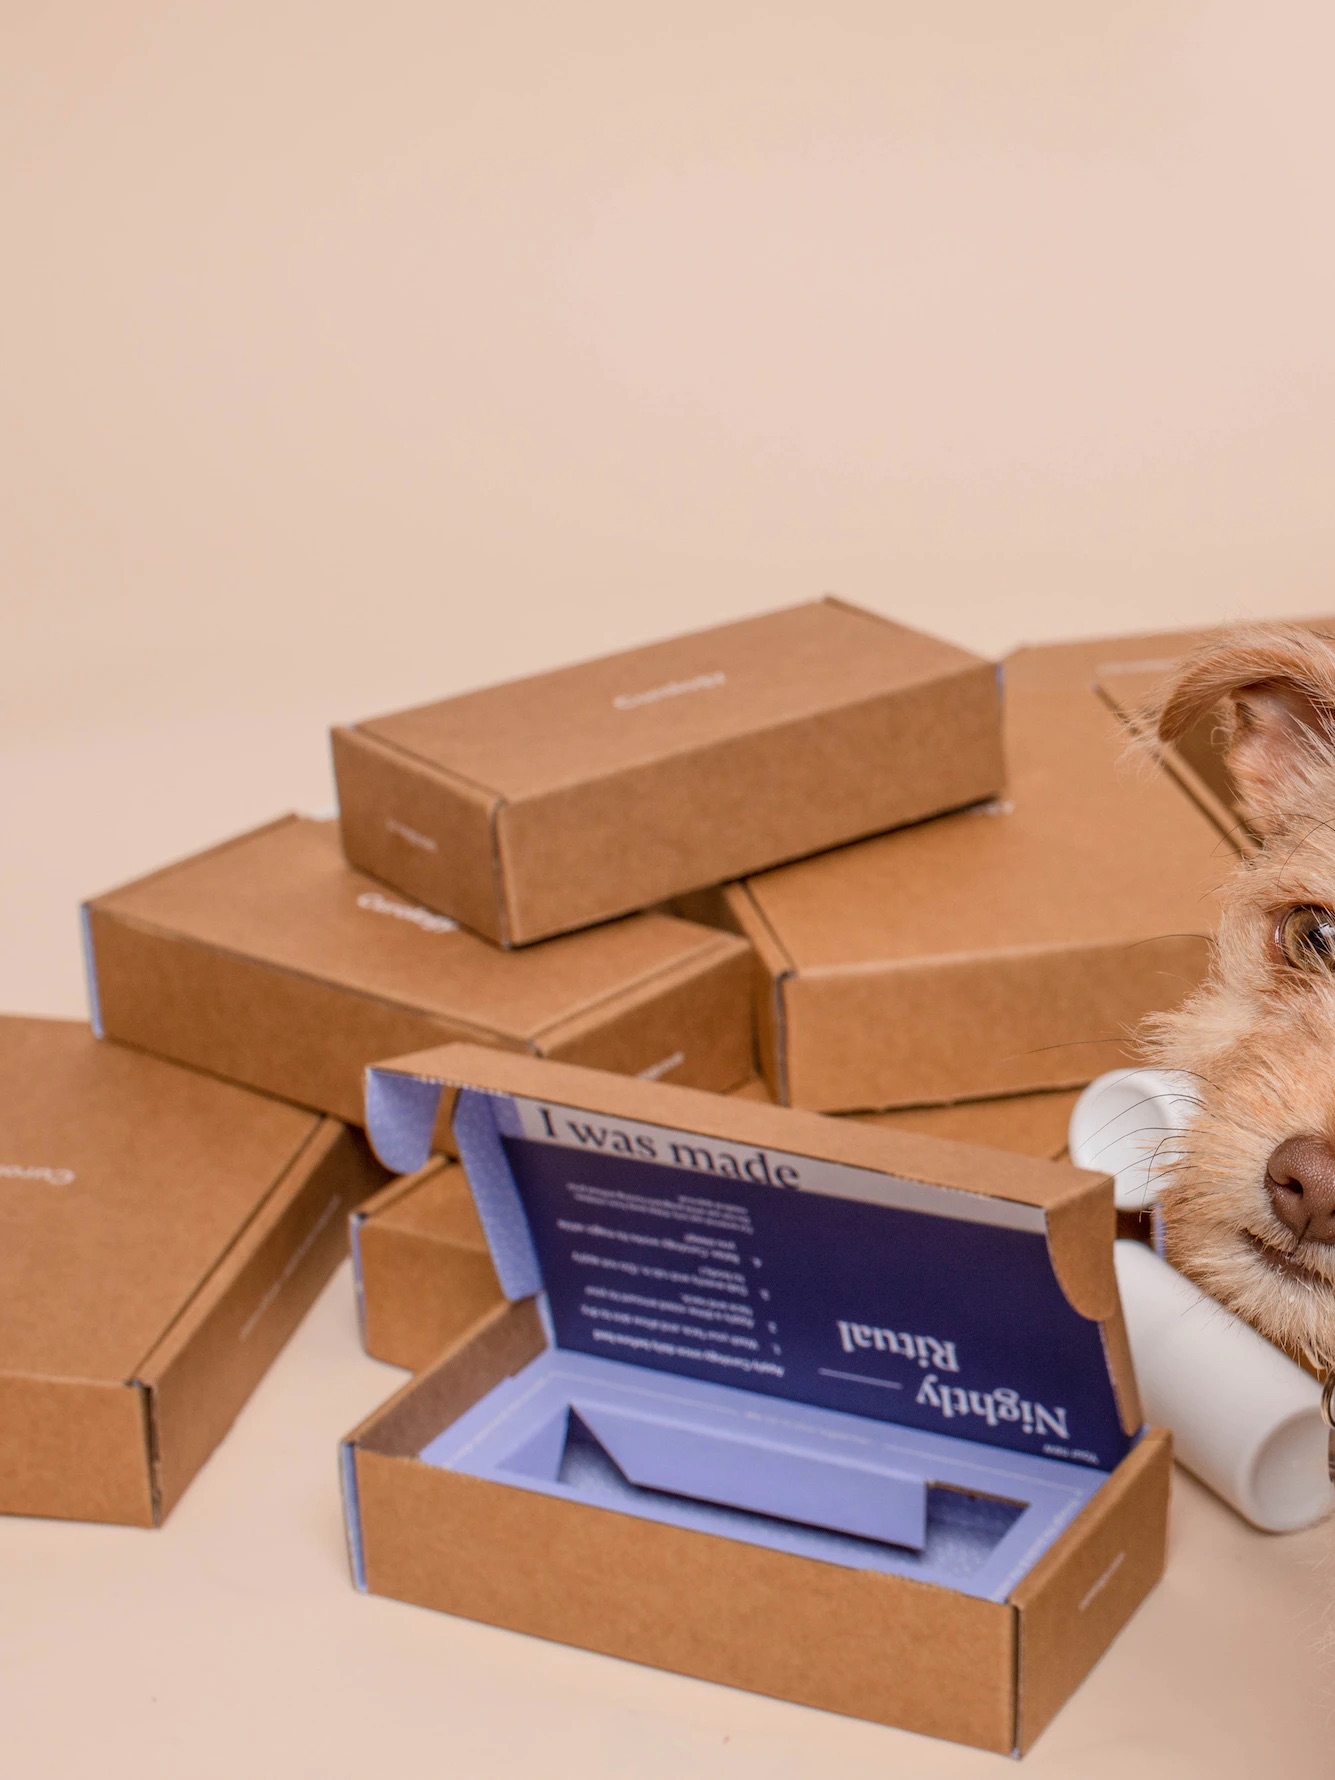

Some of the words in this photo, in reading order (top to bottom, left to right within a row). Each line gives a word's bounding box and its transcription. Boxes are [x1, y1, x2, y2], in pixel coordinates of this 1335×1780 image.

[538, 1107, 556, 1139] I
[567, 1118, 657, 1160] was
[669, 1141, 800, 1190] made
[835, 1319, 961, 1374] Ritual
[915, 1374, 1072, 1440] Nightly
